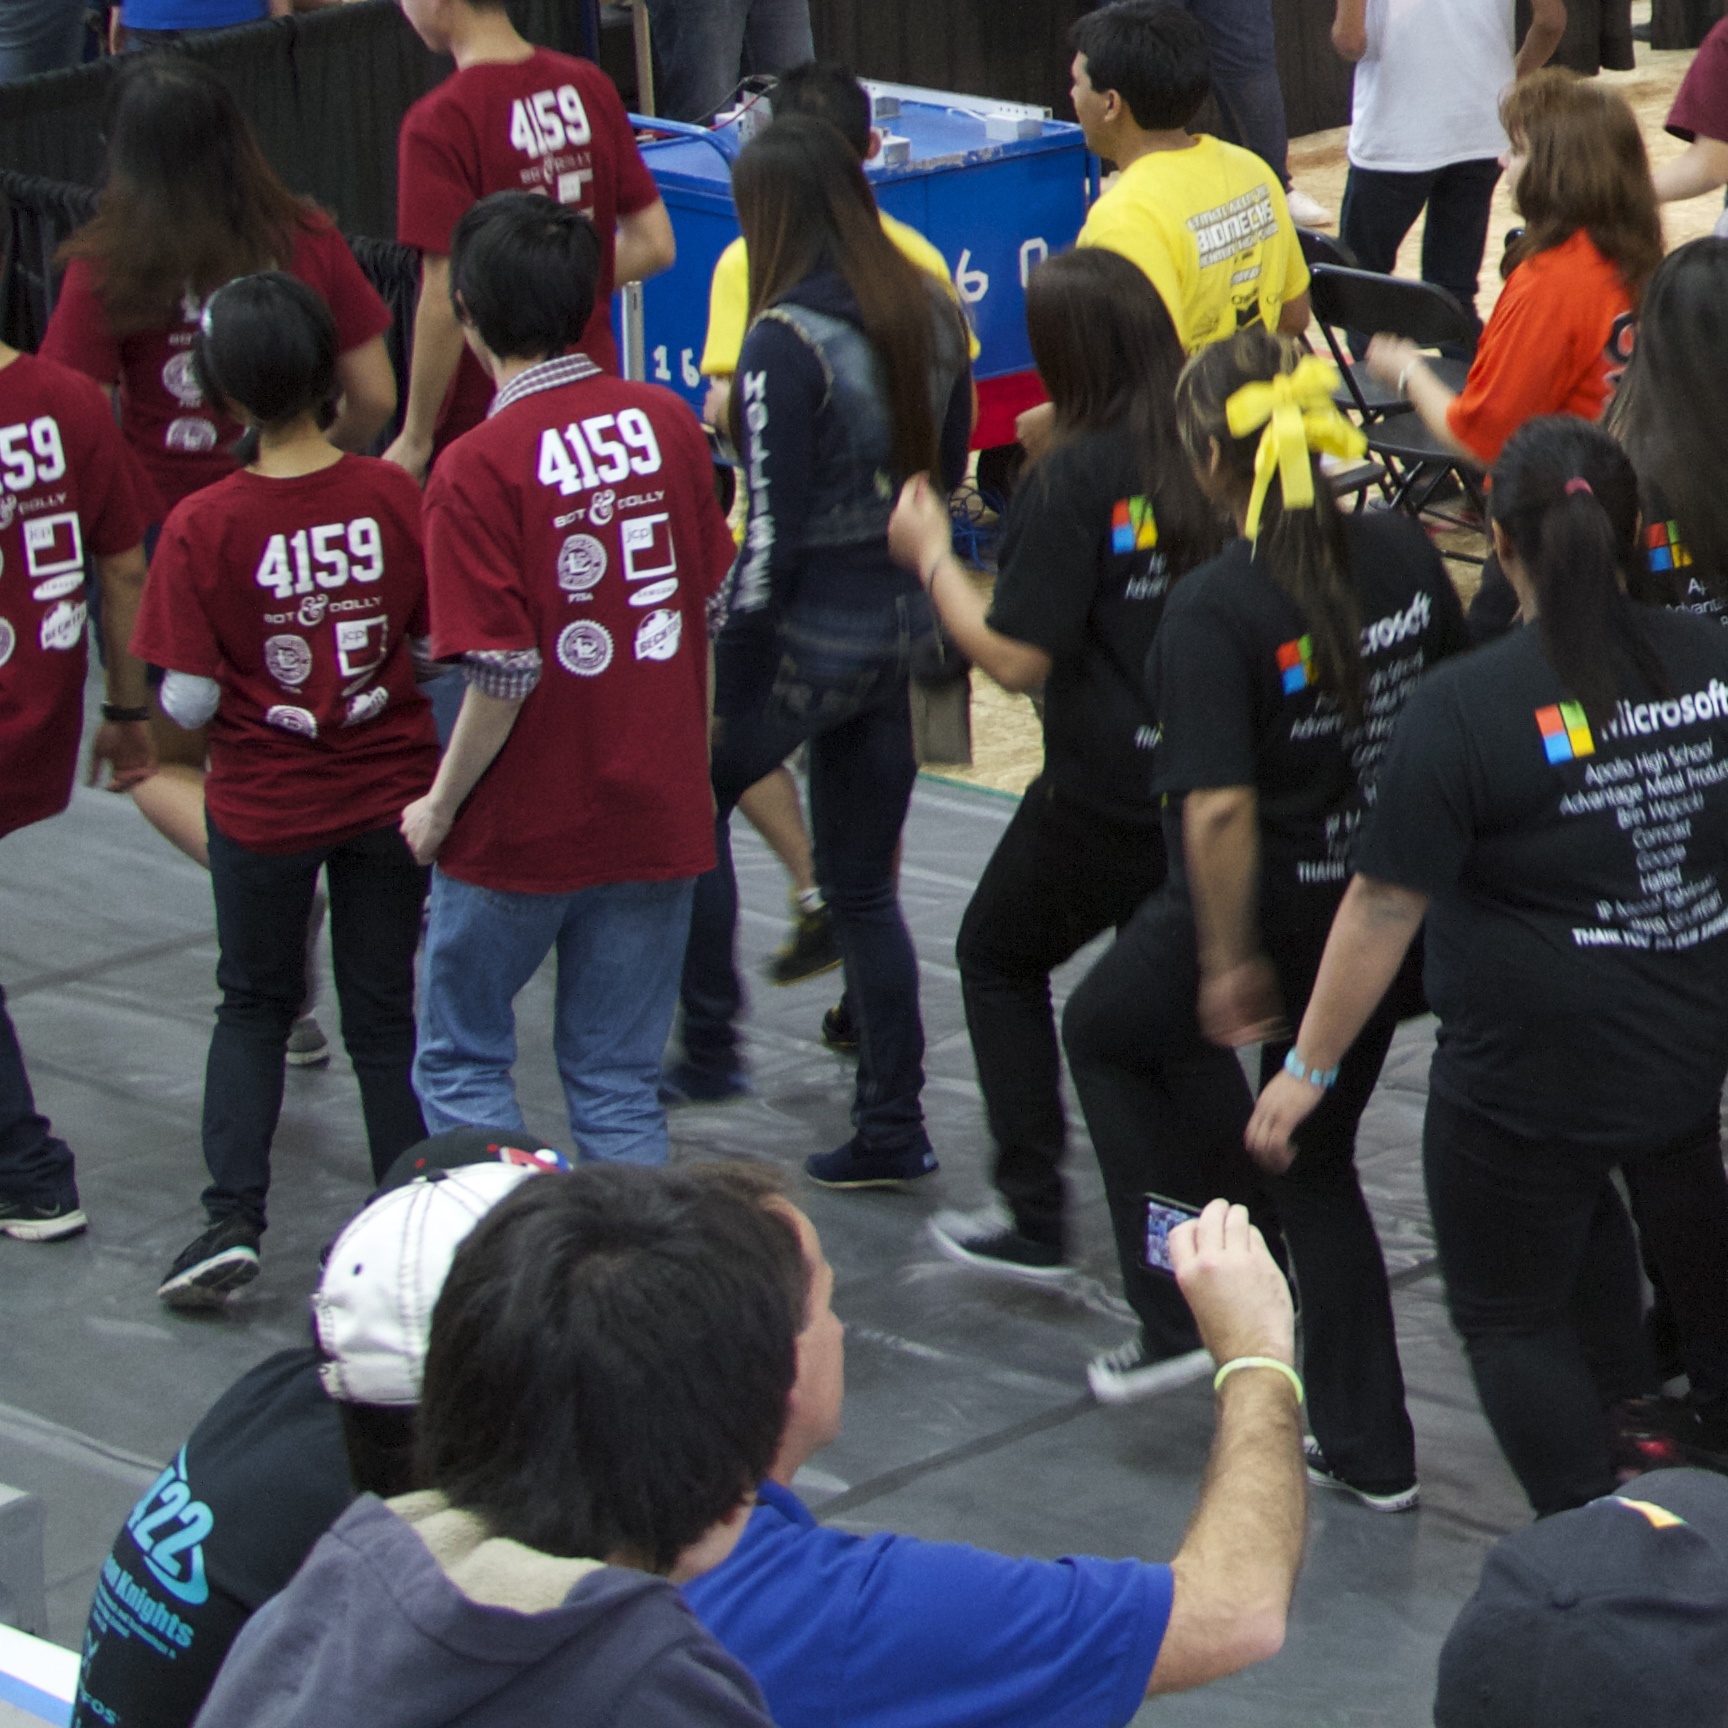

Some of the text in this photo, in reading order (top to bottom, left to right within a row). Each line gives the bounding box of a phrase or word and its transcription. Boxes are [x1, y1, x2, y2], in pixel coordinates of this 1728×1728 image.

[511, 83, 592, 159] 4159
[537, 407, 662, 496] 4159
[553, 488, 665, 528] BOT & DOLLY
[626, 526, 651, 543] jcp
[256, 517, 385, 600] 4159
[263, 593, 383, 626] BOT & DOLLY
[341, 629, 365, 644] jcp
[115, 1569, 195, 1649] Knights
